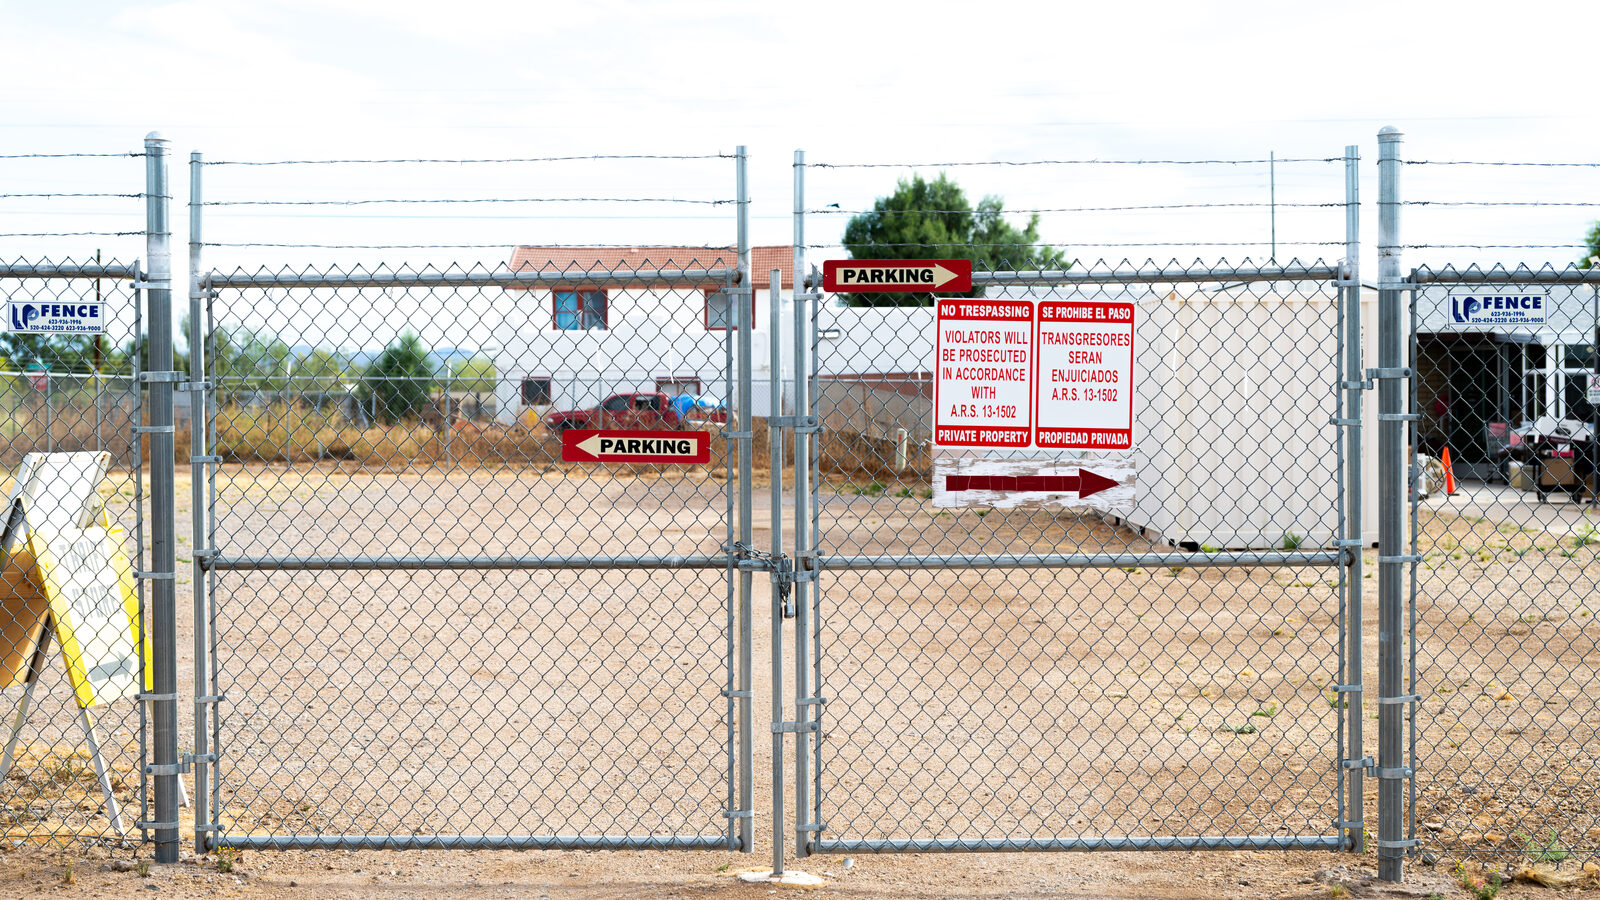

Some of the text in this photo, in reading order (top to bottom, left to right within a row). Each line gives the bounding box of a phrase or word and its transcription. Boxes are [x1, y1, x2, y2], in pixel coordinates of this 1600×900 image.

[843, 269, 934, 283] PARKING
[1483, 296, 1542, 310] FENCE
[41, 304, 99, 318] FENCE
[941, 304, 1030, 318] NO TRESPASSING
[1042, 306, 1131, 320] SE PROHIBE EL PASO
[945, 330, 1028, 345] VIOLATORS WILL
[1041, 332, 1130, 347] TRANSGRESORES
[942, 348, 1027, 363] BE PROSECUTED
[1068, 351, 1102, 364] SERAN
[942, 367, 1026, 381] IN ACCORDANCE
[1051, 369, 1119, 383] ENJUICIADOS
[971, 386, 996, 399] WITH
[1051, 387, 1118, 402] A.R.S. 13-1502
[950, 404, 1017, 419] A.R.S. 13-1502
[938, 430, 1029, 443] PRIVATE PROPERTY
[1039, 431, 1129, 445] PROPIEDAD PRIVADA
[600, 439, 691, 454] PARKING
